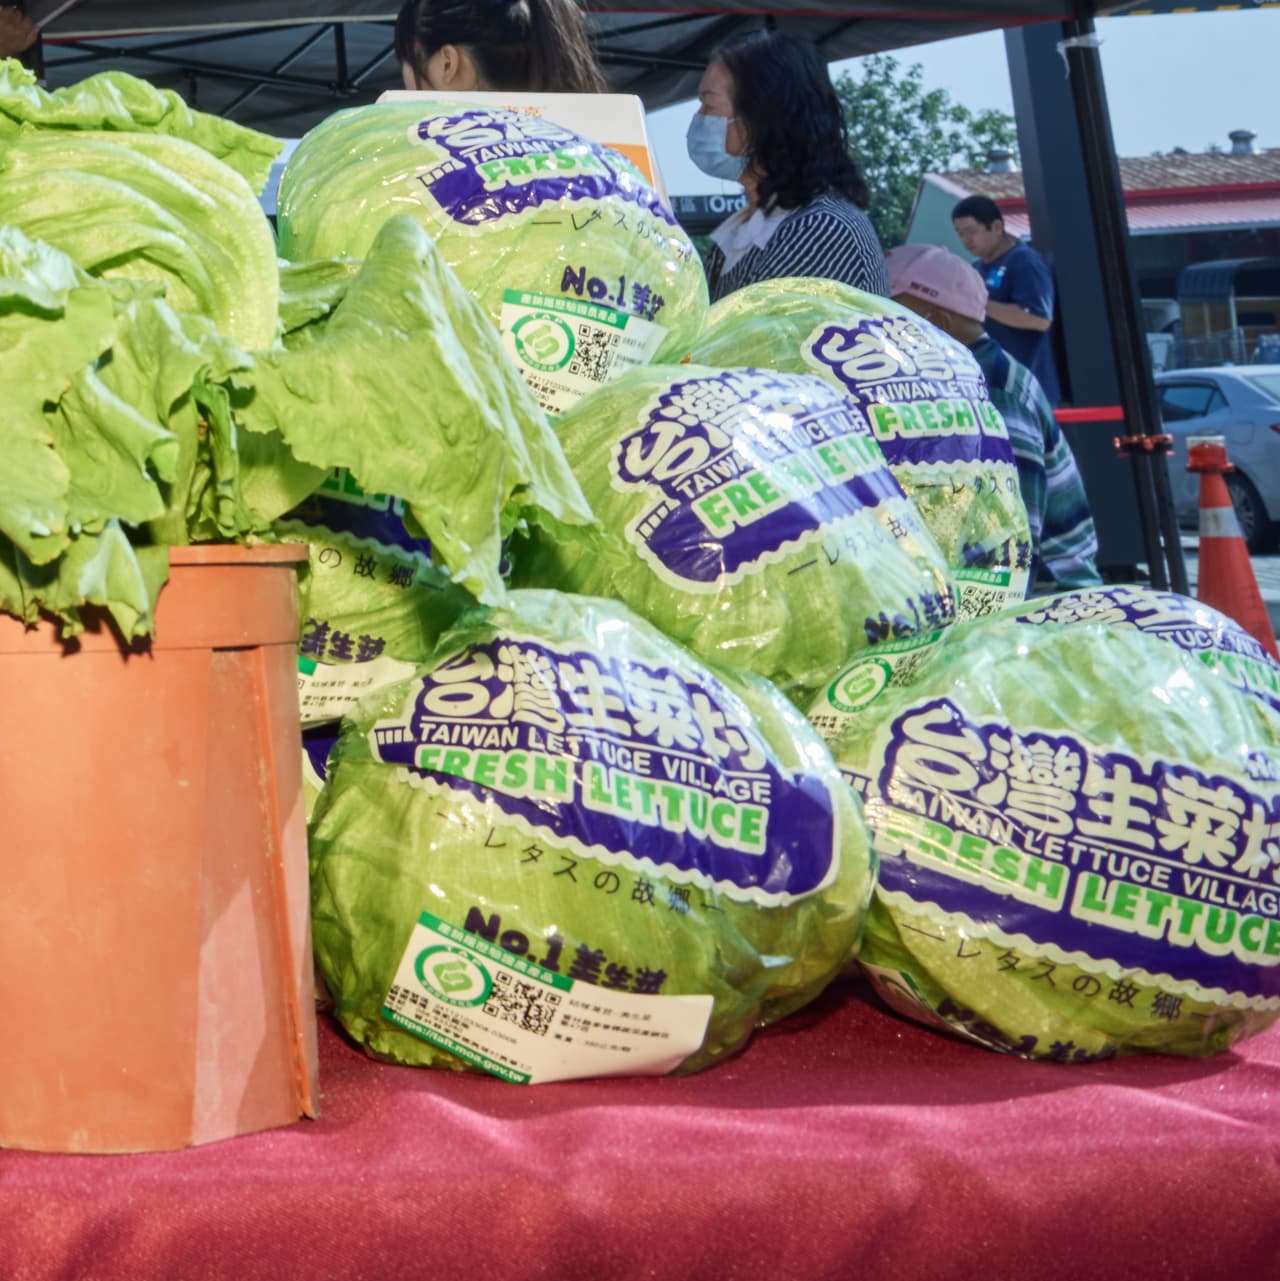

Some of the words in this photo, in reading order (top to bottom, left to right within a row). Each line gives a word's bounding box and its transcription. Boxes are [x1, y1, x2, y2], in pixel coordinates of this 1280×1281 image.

[561, 265, 627, 307] No.1
[873, 401, 976, 433] FRESH
[421, 644, 770, 773] 台灣生菜村
[418, 722, 519, 750] TAIWAN
[528, 726, 652, 776] LETTUCE
[662, 755, 772, 805] VILLAGE
[420, 747, 568, 796] FRESH
[589, 764, 766, 846] LETTUCE
[884, 809, 1066, 900] FRESH
[1025, 832, 1172, 890] LETTUCE
[1183, 871, 1280, 915] VILLAG
[463, 906, 564, 975] No.1
